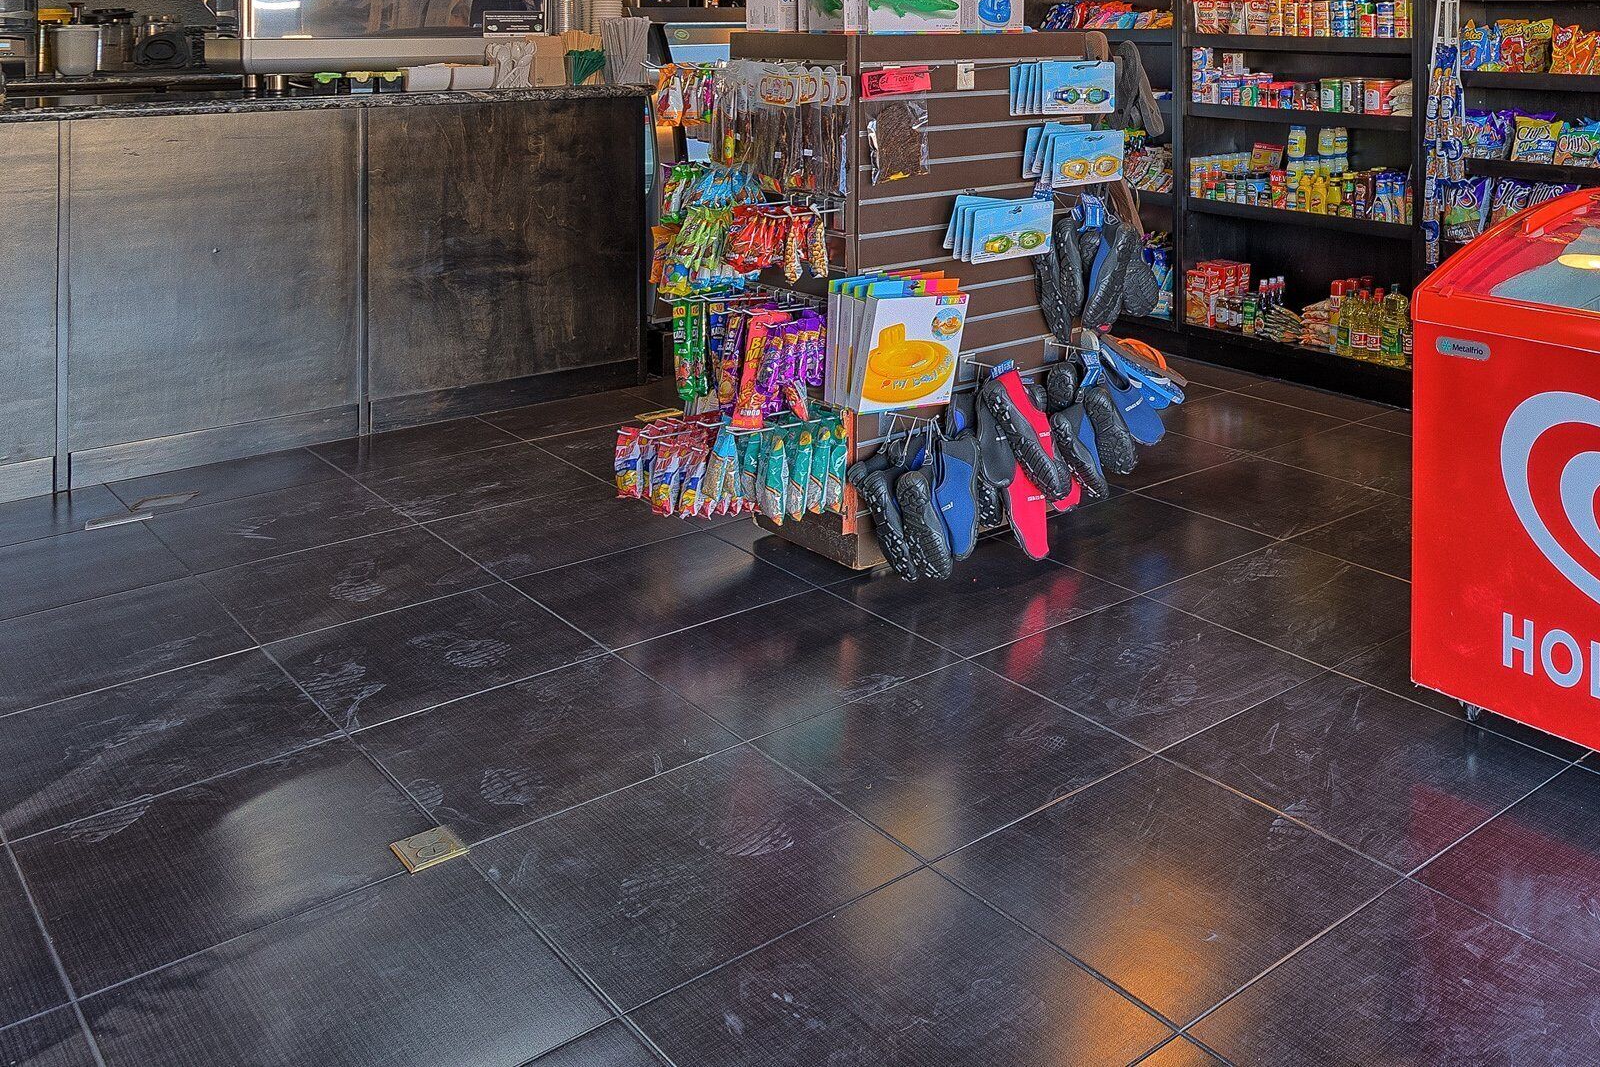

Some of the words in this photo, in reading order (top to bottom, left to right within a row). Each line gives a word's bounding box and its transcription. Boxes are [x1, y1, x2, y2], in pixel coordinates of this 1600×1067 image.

[1517, 124, 1551, 140] Chips
[1559, 136, 1592, 153] Chips
[937, 296, 966, 305] INTEX
[1452, 341, 1484, 356] Metalfrio
